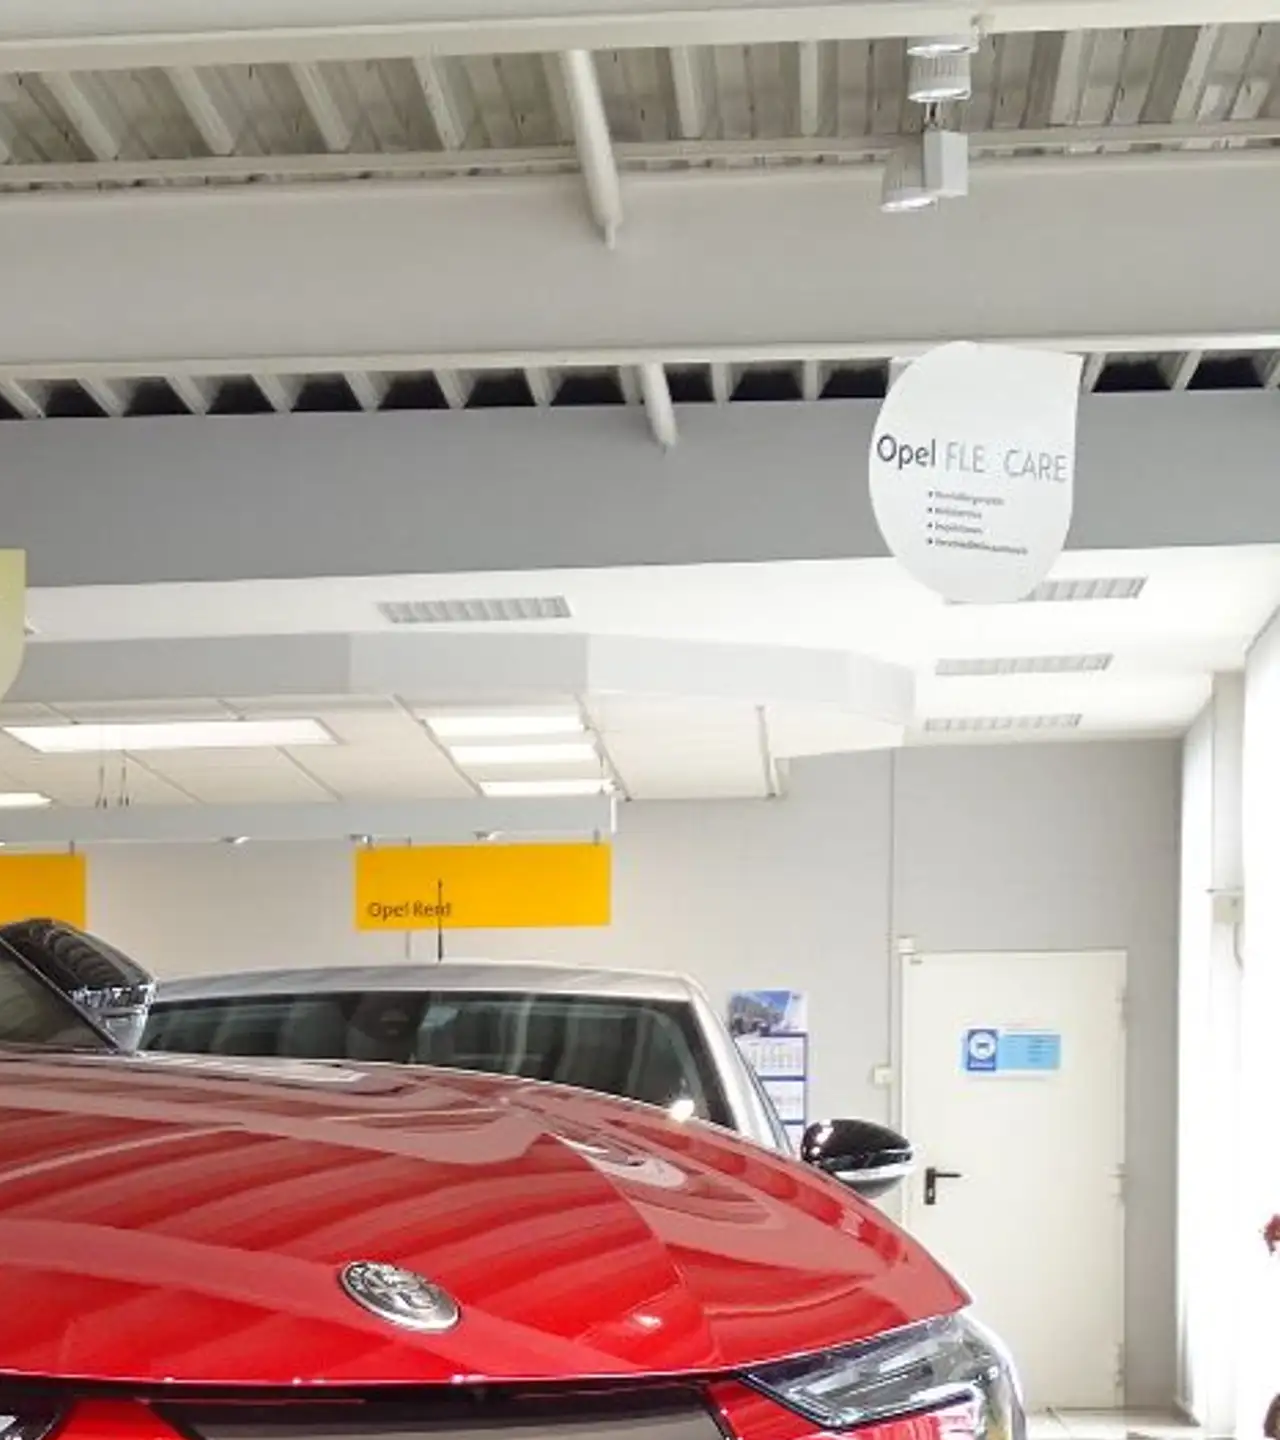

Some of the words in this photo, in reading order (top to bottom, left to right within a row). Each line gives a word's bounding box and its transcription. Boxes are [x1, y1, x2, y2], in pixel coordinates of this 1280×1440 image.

[876, 433, 936, 470] Opel
[1003, 449, 1069, 484] CARE
[367, 901, 409, 922] Opel
